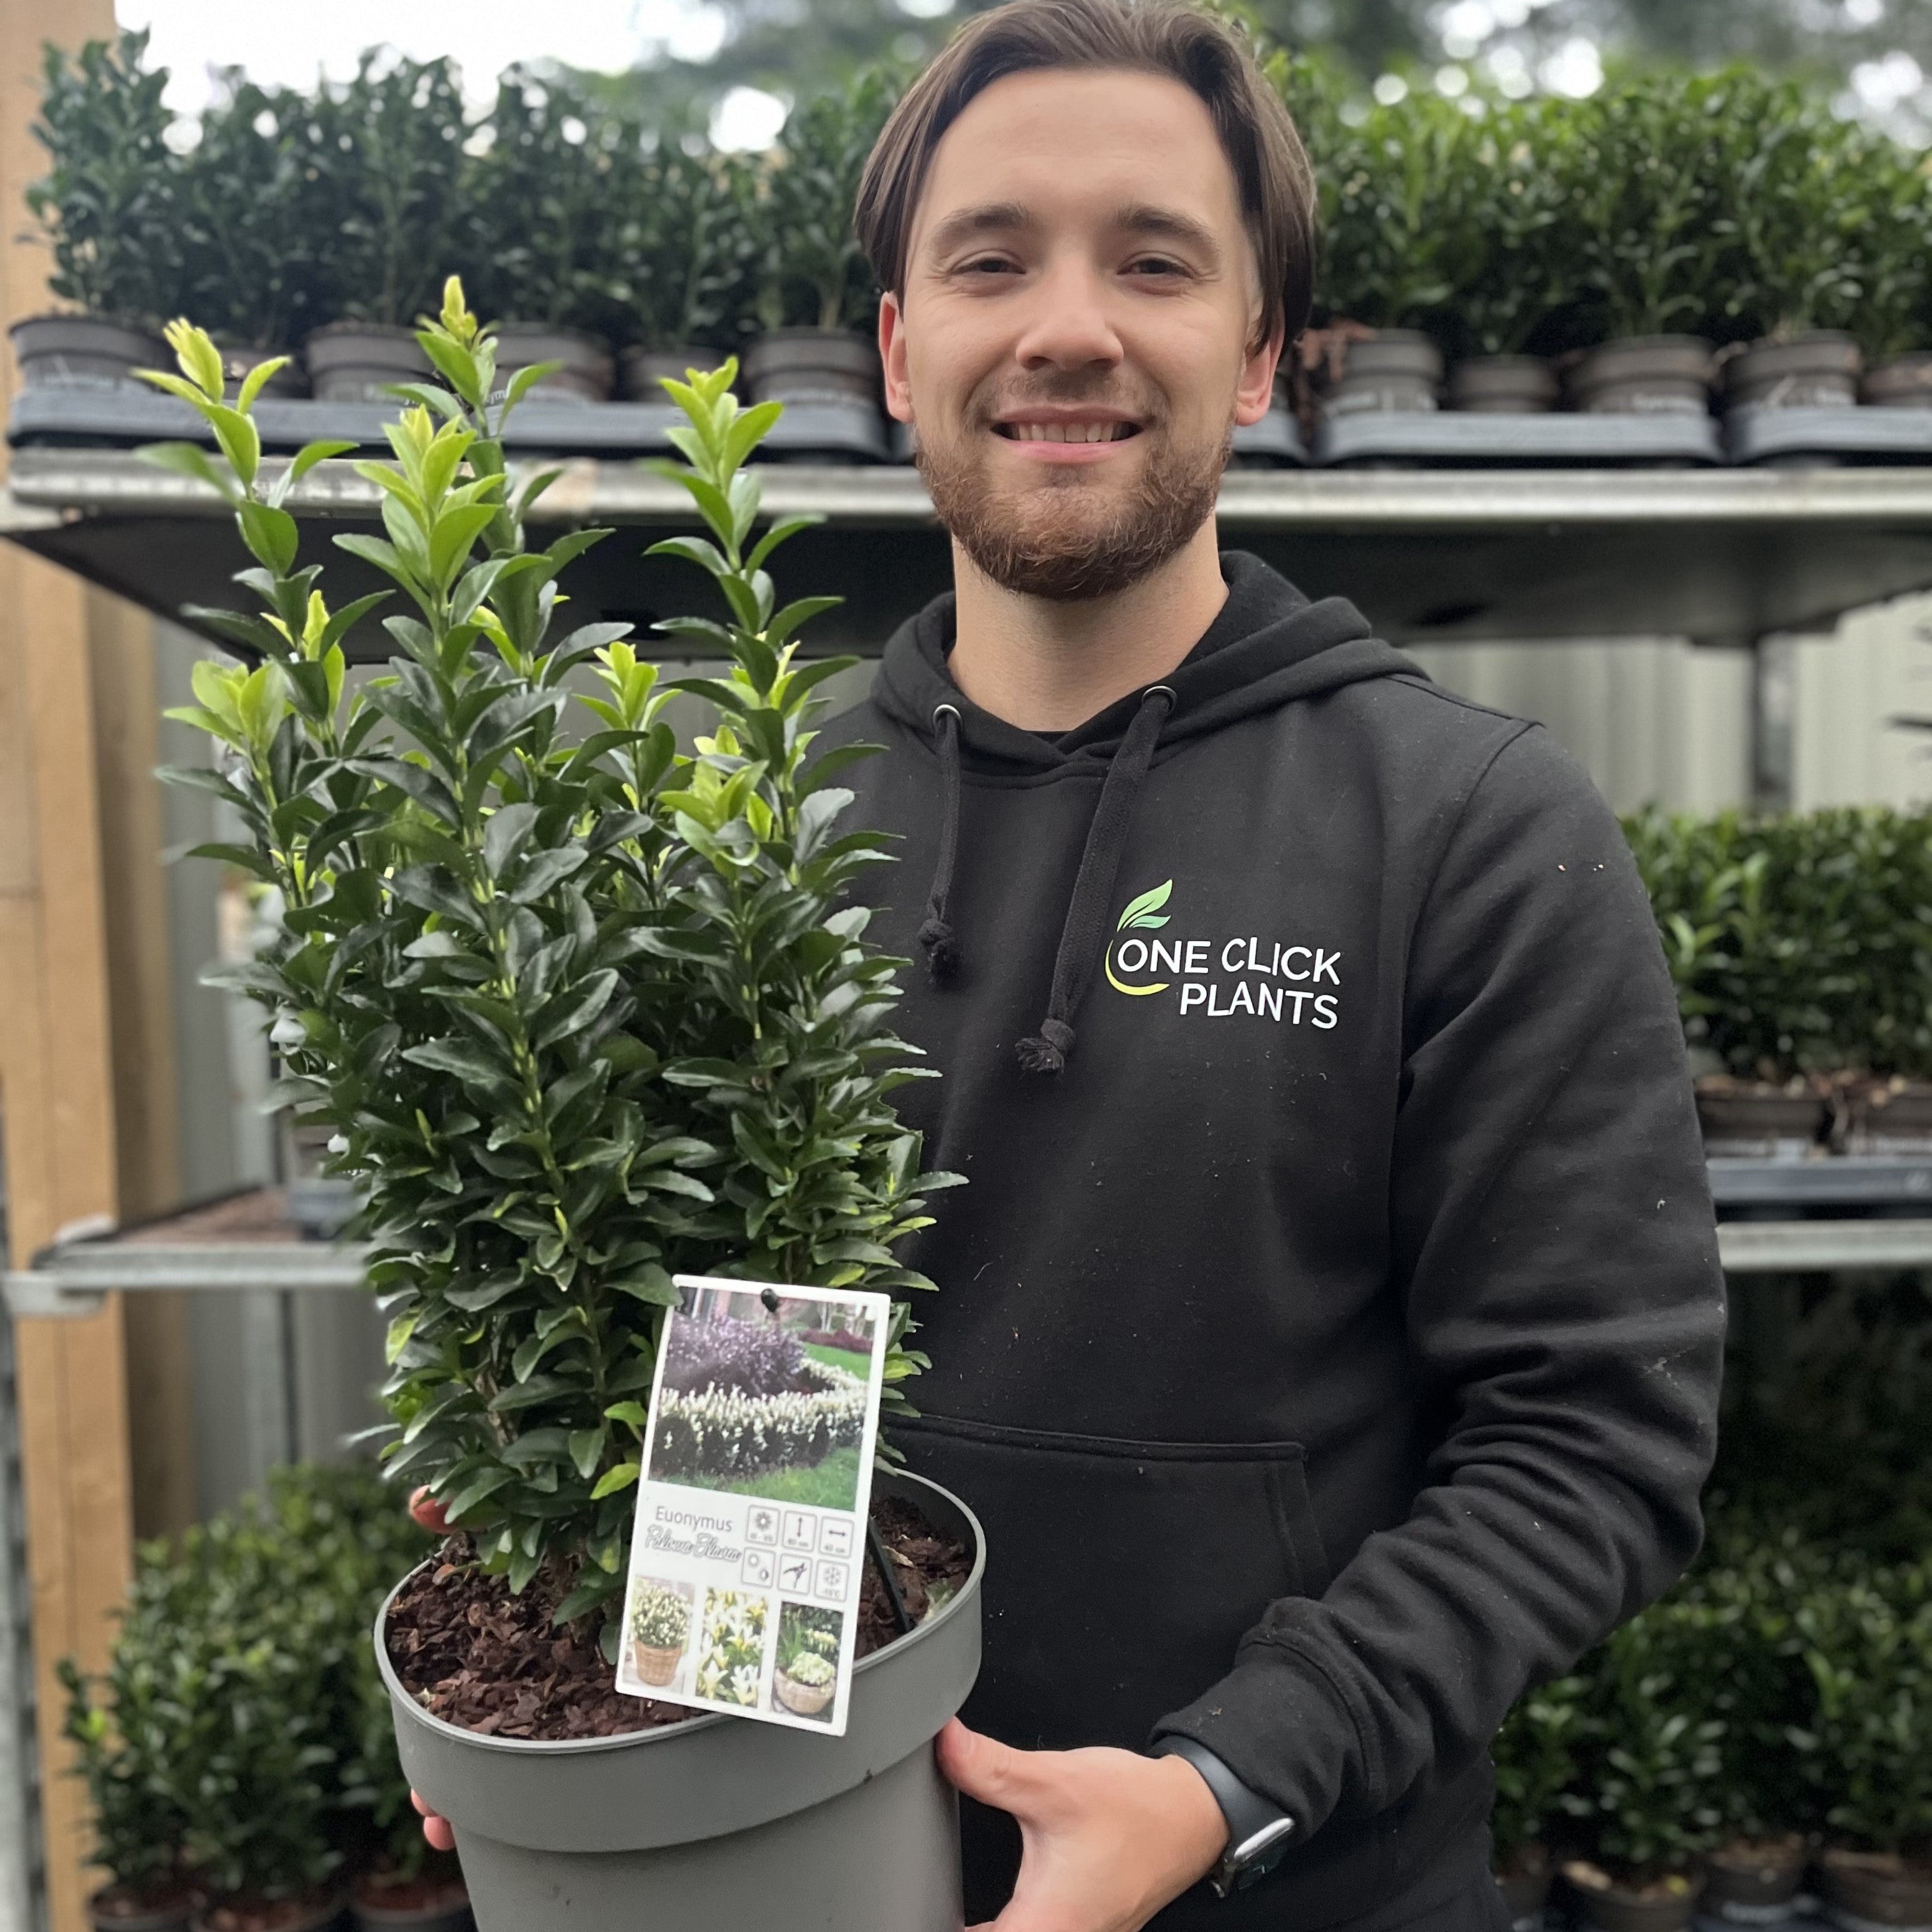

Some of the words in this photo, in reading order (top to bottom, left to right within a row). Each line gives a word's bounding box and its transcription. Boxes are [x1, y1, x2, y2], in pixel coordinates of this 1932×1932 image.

[1117, 939, 1211, 974] ONE
[1222, 937, 1341, 985] CLICK
[1180, 981, 1338, 1029] PLANTS
[656, 1505, 733, 1532] Euonymus
